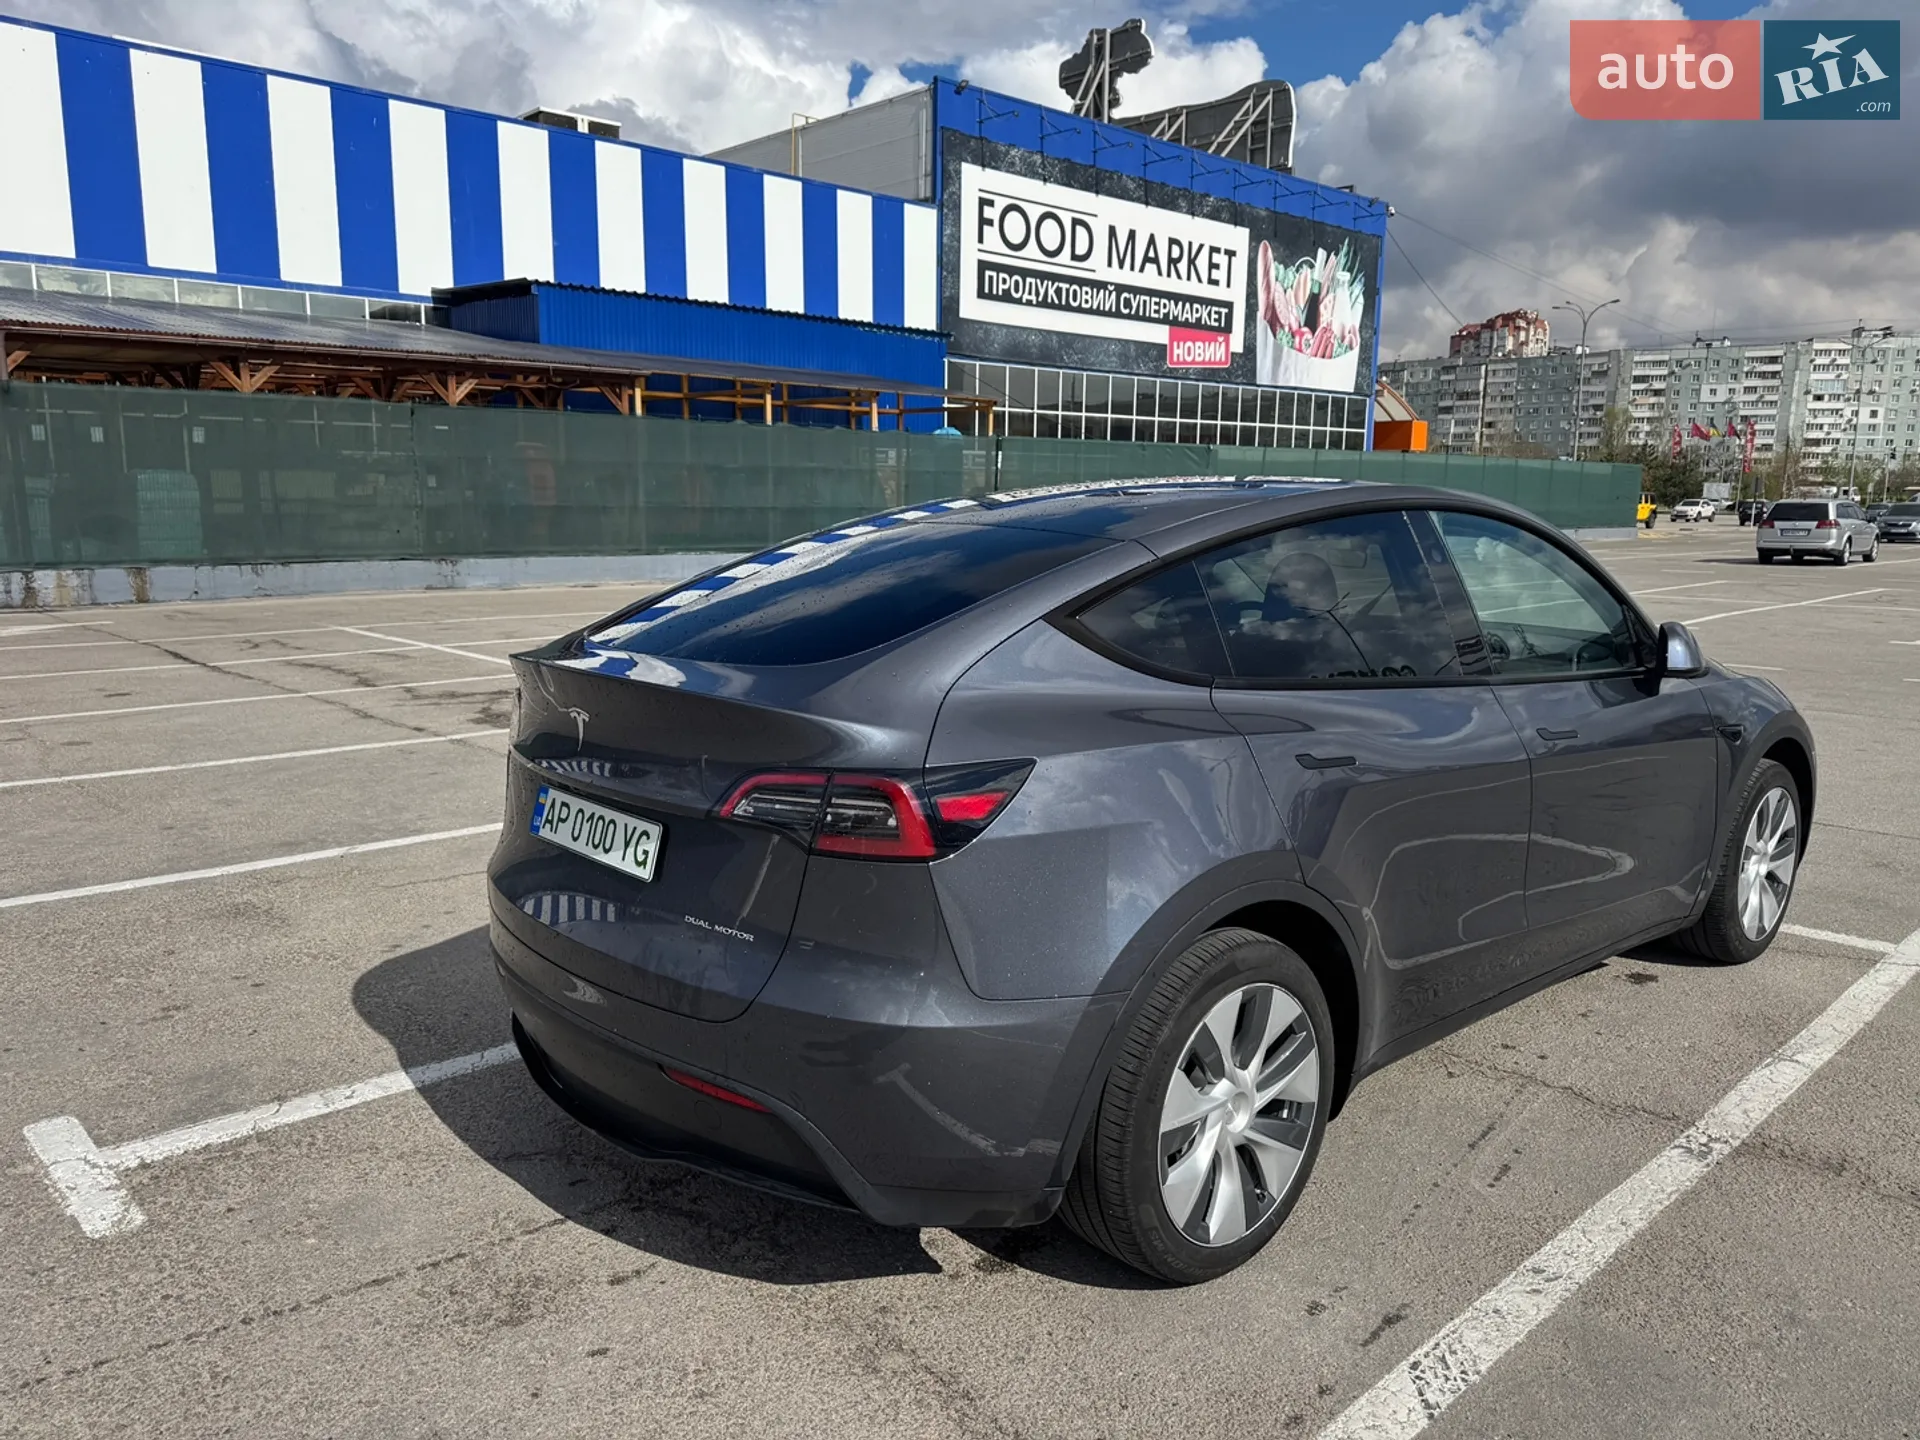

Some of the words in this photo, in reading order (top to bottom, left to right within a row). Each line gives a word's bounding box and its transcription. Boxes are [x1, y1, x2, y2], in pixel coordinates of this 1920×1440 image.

[977, 196, 1094, 263] FOOD
[1107, 224, 1237, 289] MARKET
[984, 269, 1116, 313] ПРОДУКТОВИЙ
[1119, 291, 1229, 328] СУПЕРМАРКЕТ
[1172, 336, 1226, 363] НОВИЙ
[541, 797, 570, 835] AP
[570, 808, 617, 855] 0100
[622, 823, 651, 870] YG
[684, 914, 712, 930] DUAL
[713, 925, 755, 942] MOTOR
